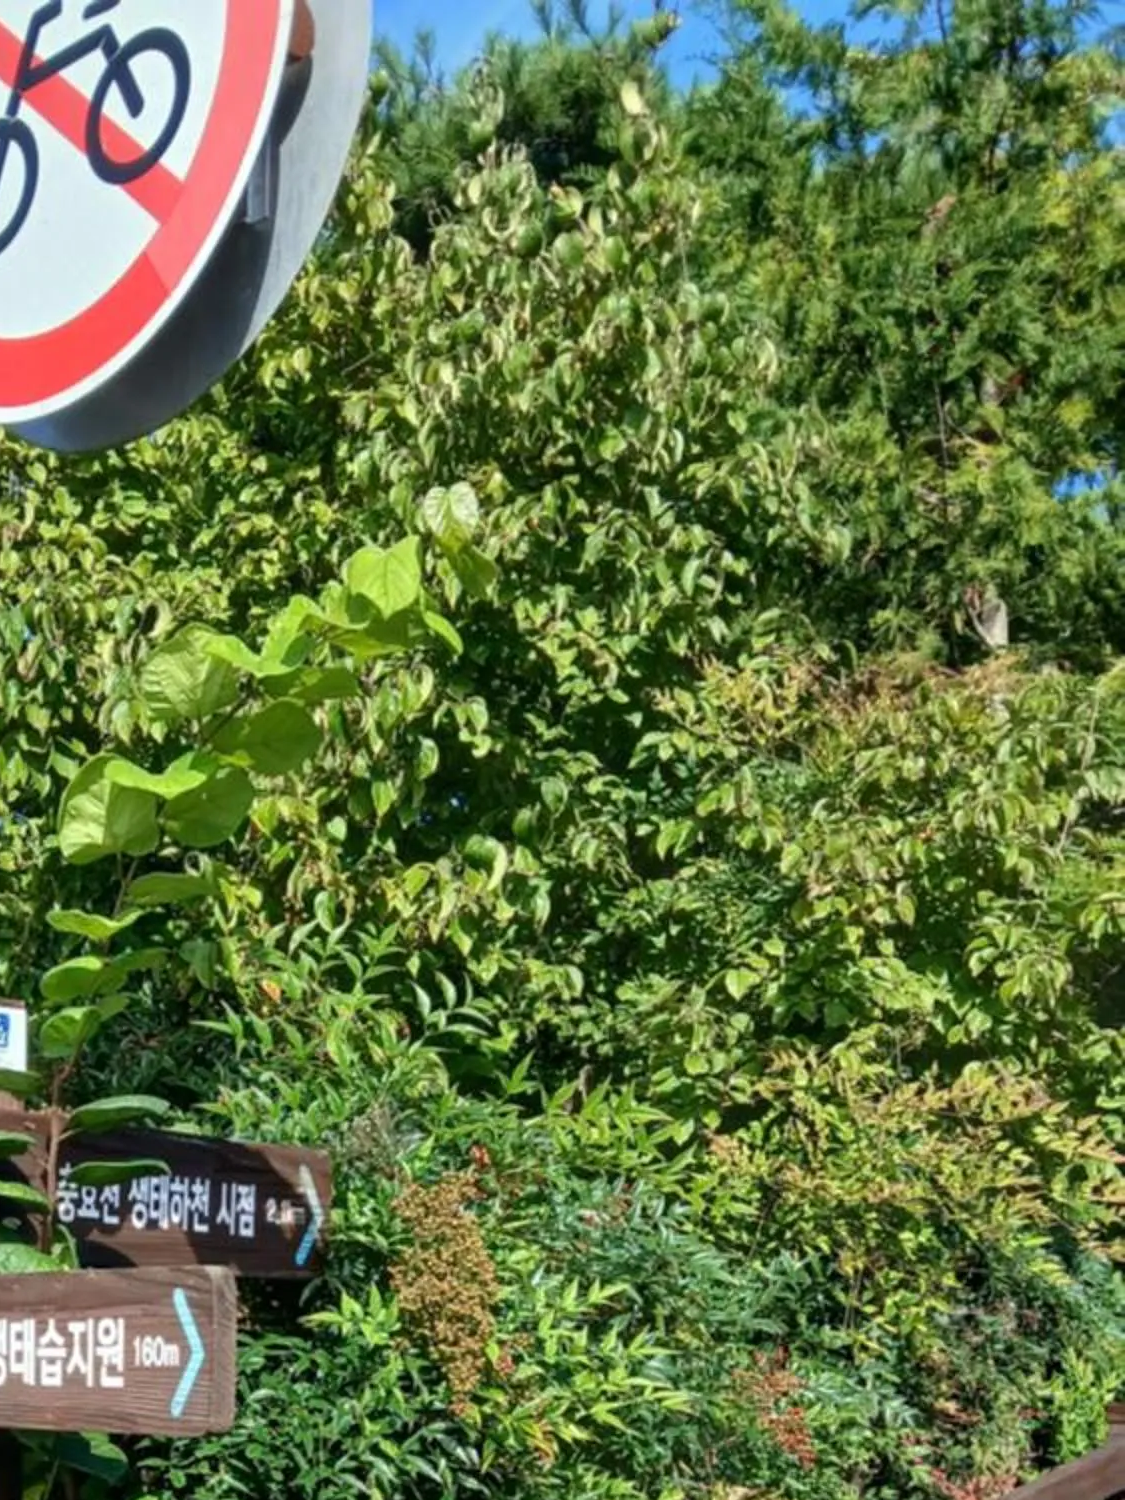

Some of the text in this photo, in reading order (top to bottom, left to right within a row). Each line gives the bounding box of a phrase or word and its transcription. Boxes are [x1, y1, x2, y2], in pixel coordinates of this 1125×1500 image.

[127, 1175, 211, 1234] 생태하천
[215, 1182, 257, 1238] 시점
[132, 1334, 180, 1369] 160m
